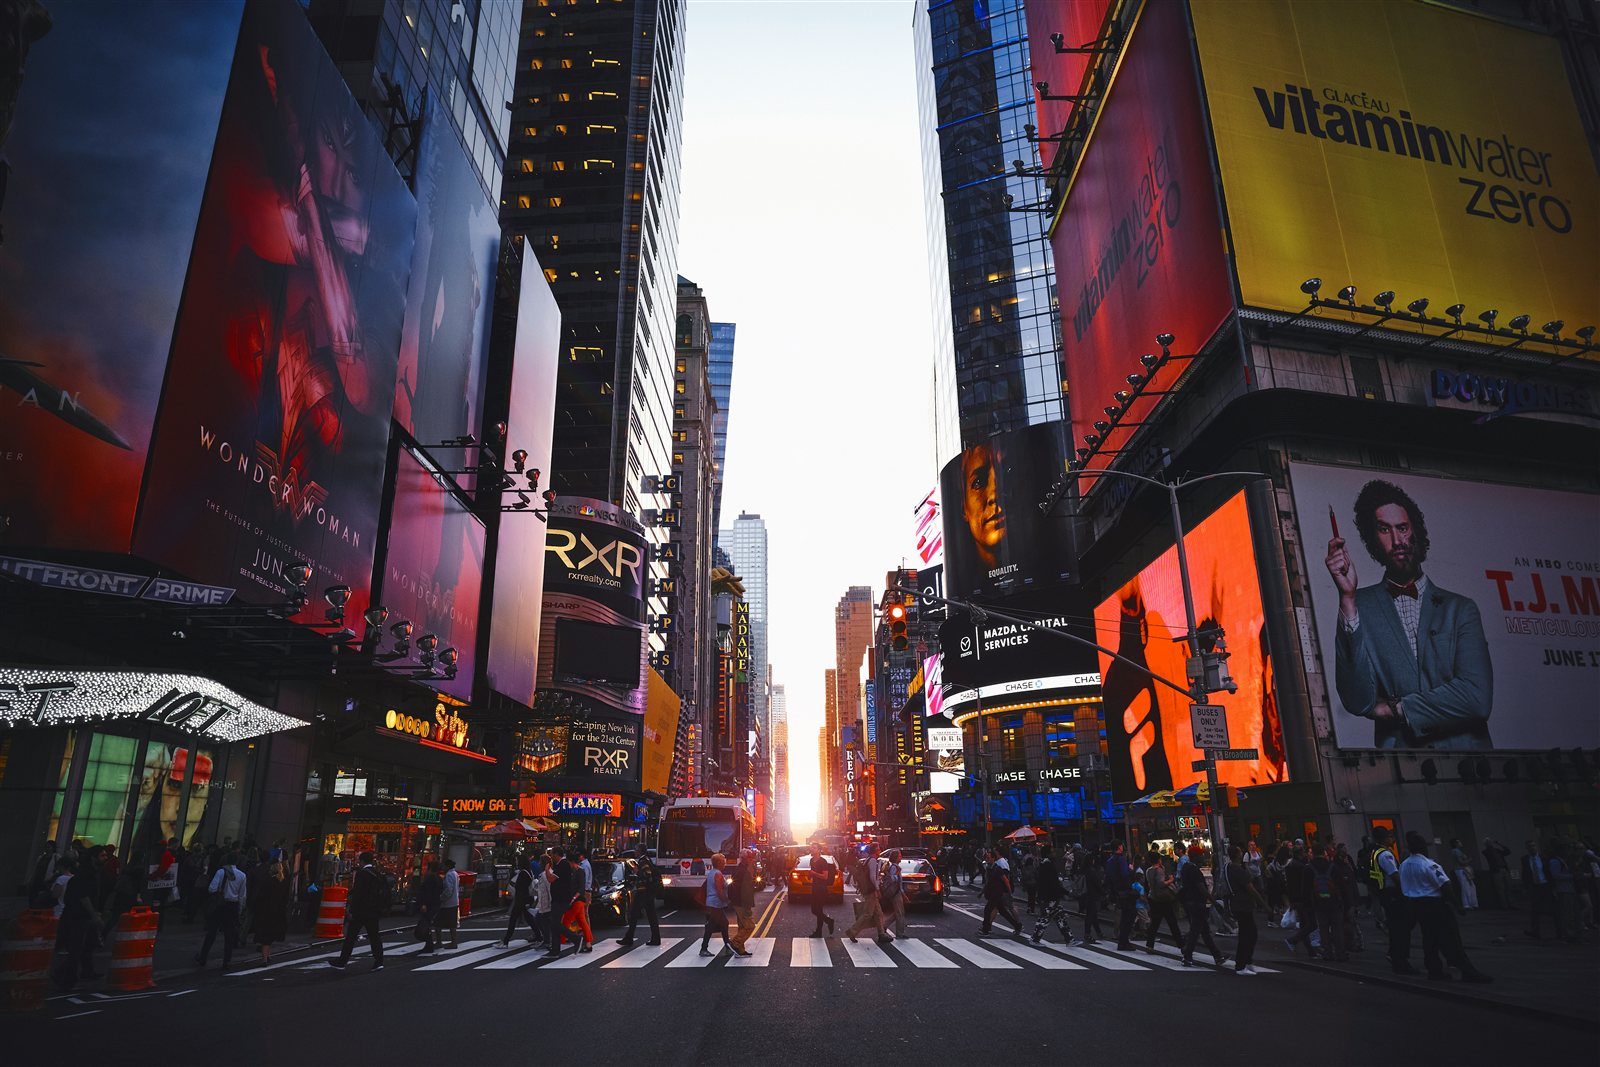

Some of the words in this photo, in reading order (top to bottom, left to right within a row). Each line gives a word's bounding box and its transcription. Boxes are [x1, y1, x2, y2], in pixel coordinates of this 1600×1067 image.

[1323, 86, 1390, 114] GLACÉAU
[1252, 83, 1553, 188] vitaminwater
[1458, 176, 1573, 234] zero
[1134, 181, 1181, 290] zero
[0, 384, 81, 412] AN
[200, 425, 293, 503] WONDER
[303, 496, 360, 548] WOMAN
[205, 498, 220, 513] THE
[224, 510, 251, 531] FUTURE
[266, 534, 292, 554] JUSTICE
[252, 548, 289, 577] JUN
[545, 528, 641, 585] RXR
[1514, 557, 1530, 567] AN
[1535, 559, 1561, 569] HBO
[154, 582, 225, 604] PRIME
[392, 567, 437, 609] WONDER
[1485, 569, 1561, 614] T.J.
[1561, 575, 1600, 616] M
[737, 602, 749, 670] MADAME
[984, 624, 1017, 640] MAZDA
[1505, 616, 1600, 638] METICULOU
[984, 634, 1029, 651] SERVICES
[1543, 649, 1586, 667] JUNE
[1005, 681, 1033, 692] CHASE
[1197, 708, 1219, 717] BUSES
[607, 722, 623, 732] New
[624, 724, 635, 735] York
[572, 731, 586, 742] for
[587, 733, 599, 743] the
[601, 734, 615, 743] 21st
[615, 735, 636, 749] Century
[584, 746, 629, 769] RXR
[1224, 750, 1257, 760] Broadway
[593, 767, 623, 775] REALTY
[846, 750, 855, 803] REGAL
[996, 771, 1026, 783] CHASE
[1040, 768, 1081, 779] CHASE
[453, 799, 485, 812] KNOW
[549, 796, 614, 813] CHAMPS
[1179, 817, 1200, 828] SODA
